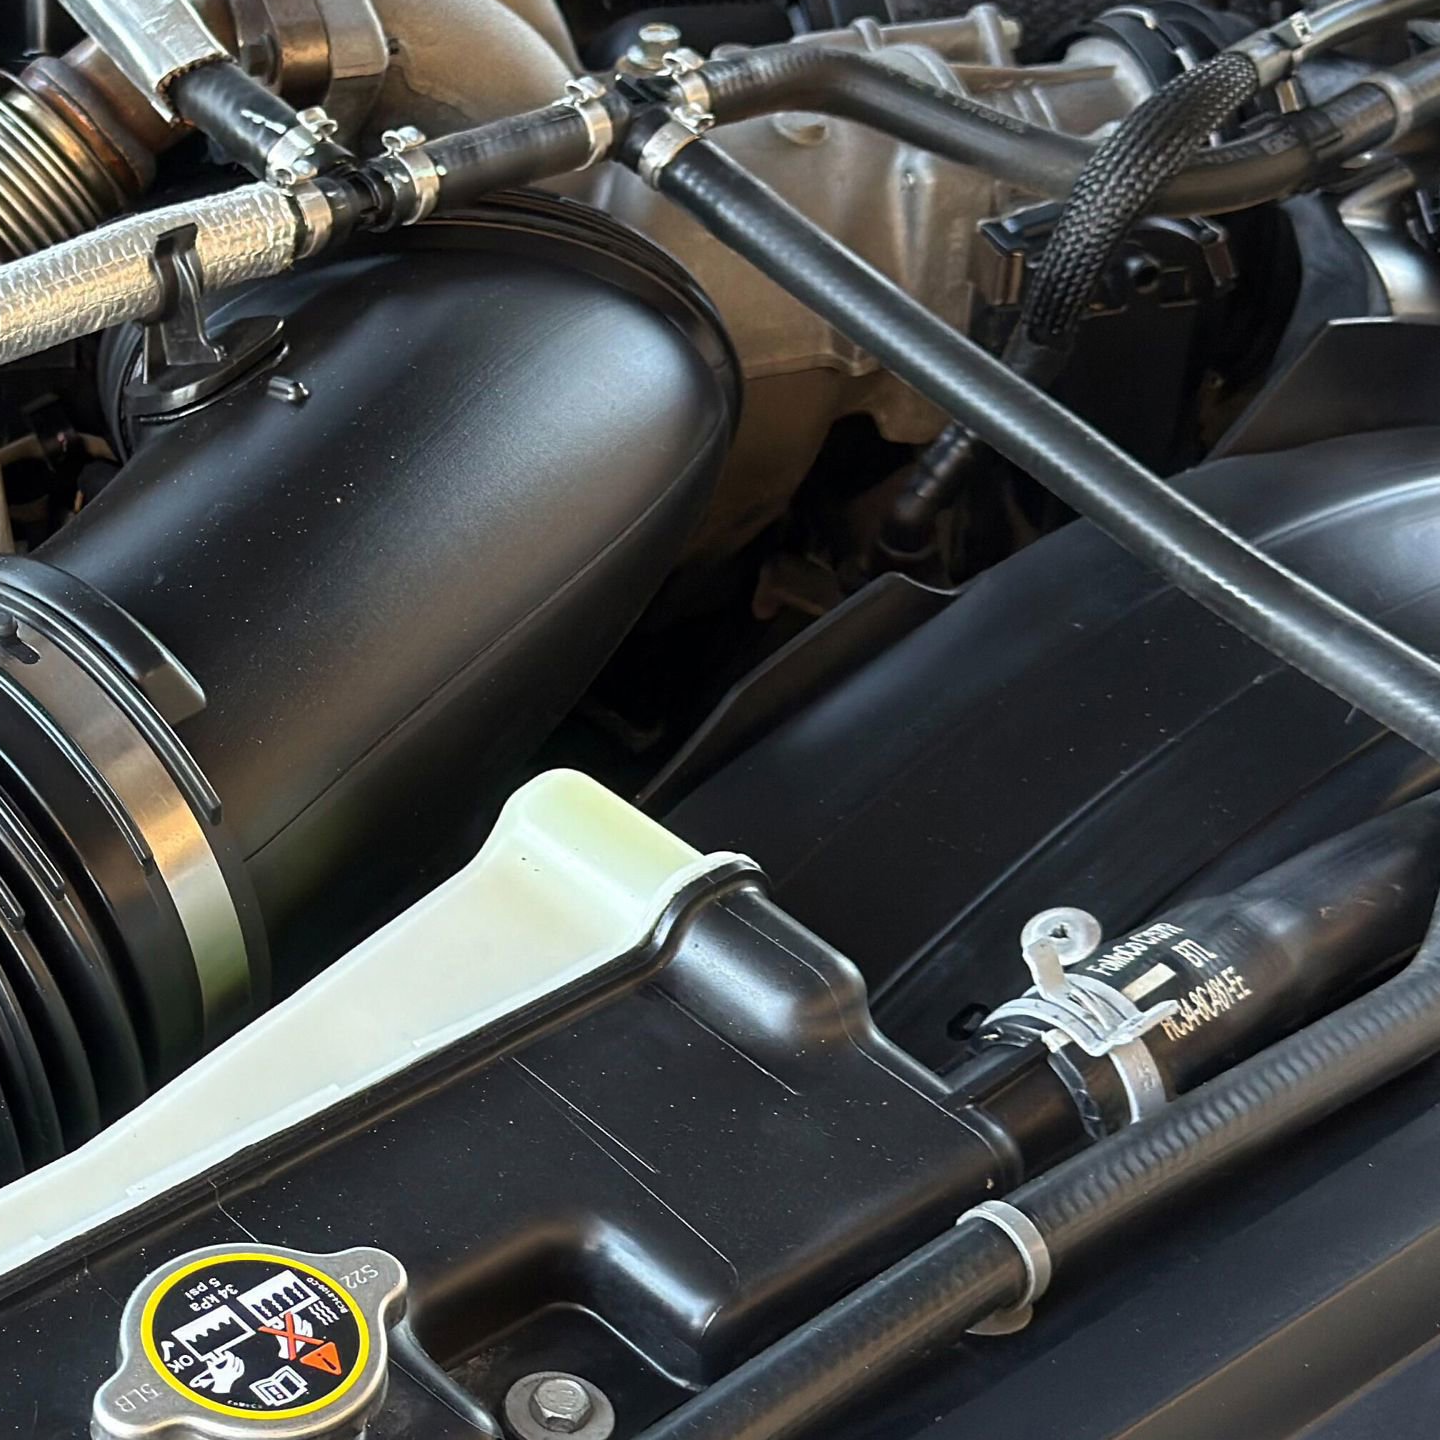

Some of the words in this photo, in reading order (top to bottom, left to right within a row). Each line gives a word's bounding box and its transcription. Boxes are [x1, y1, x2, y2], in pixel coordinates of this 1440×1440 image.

[1171, 936, 1218, 968] BTL
[182, 1279, 209, 1301] psi
[206, 1275, 220, 1289] 5
[216, 1281, 238, 1300] 34
[187, 1291, 219, 1315] kPa
[165, 1350, 196, 1375] OK
[114, 1382, 156, 1414] 5LB
